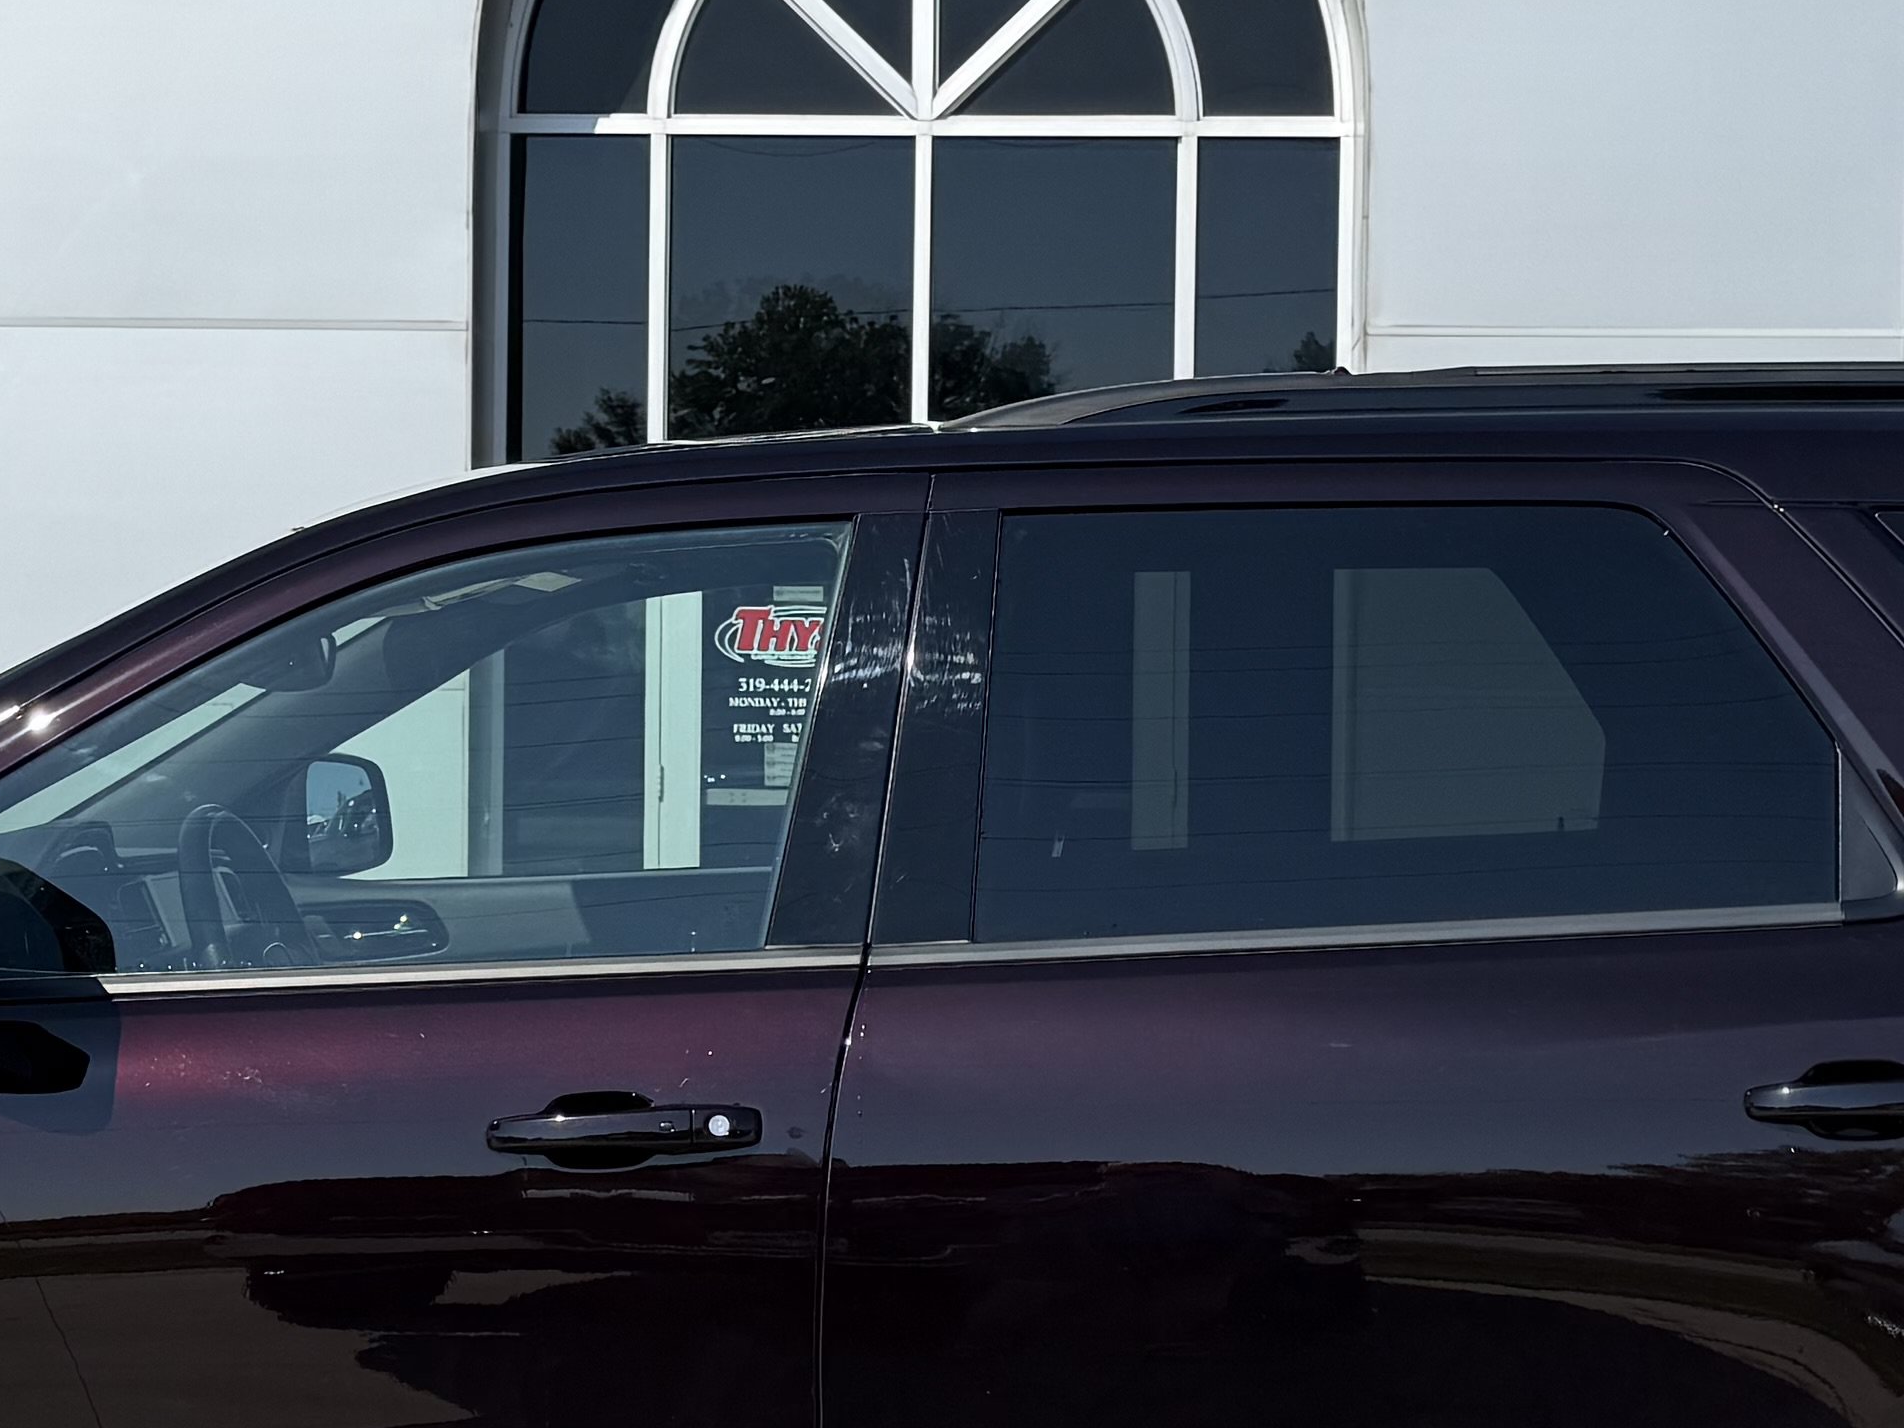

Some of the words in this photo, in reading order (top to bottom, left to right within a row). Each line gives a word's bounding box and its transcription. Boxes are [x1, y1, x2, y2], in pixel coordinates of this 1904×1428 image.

[733, 606, 825, 654] THY
[729, 697, 780, 707] MONDAY
[733, 723, 775, 733] FRIDAY
